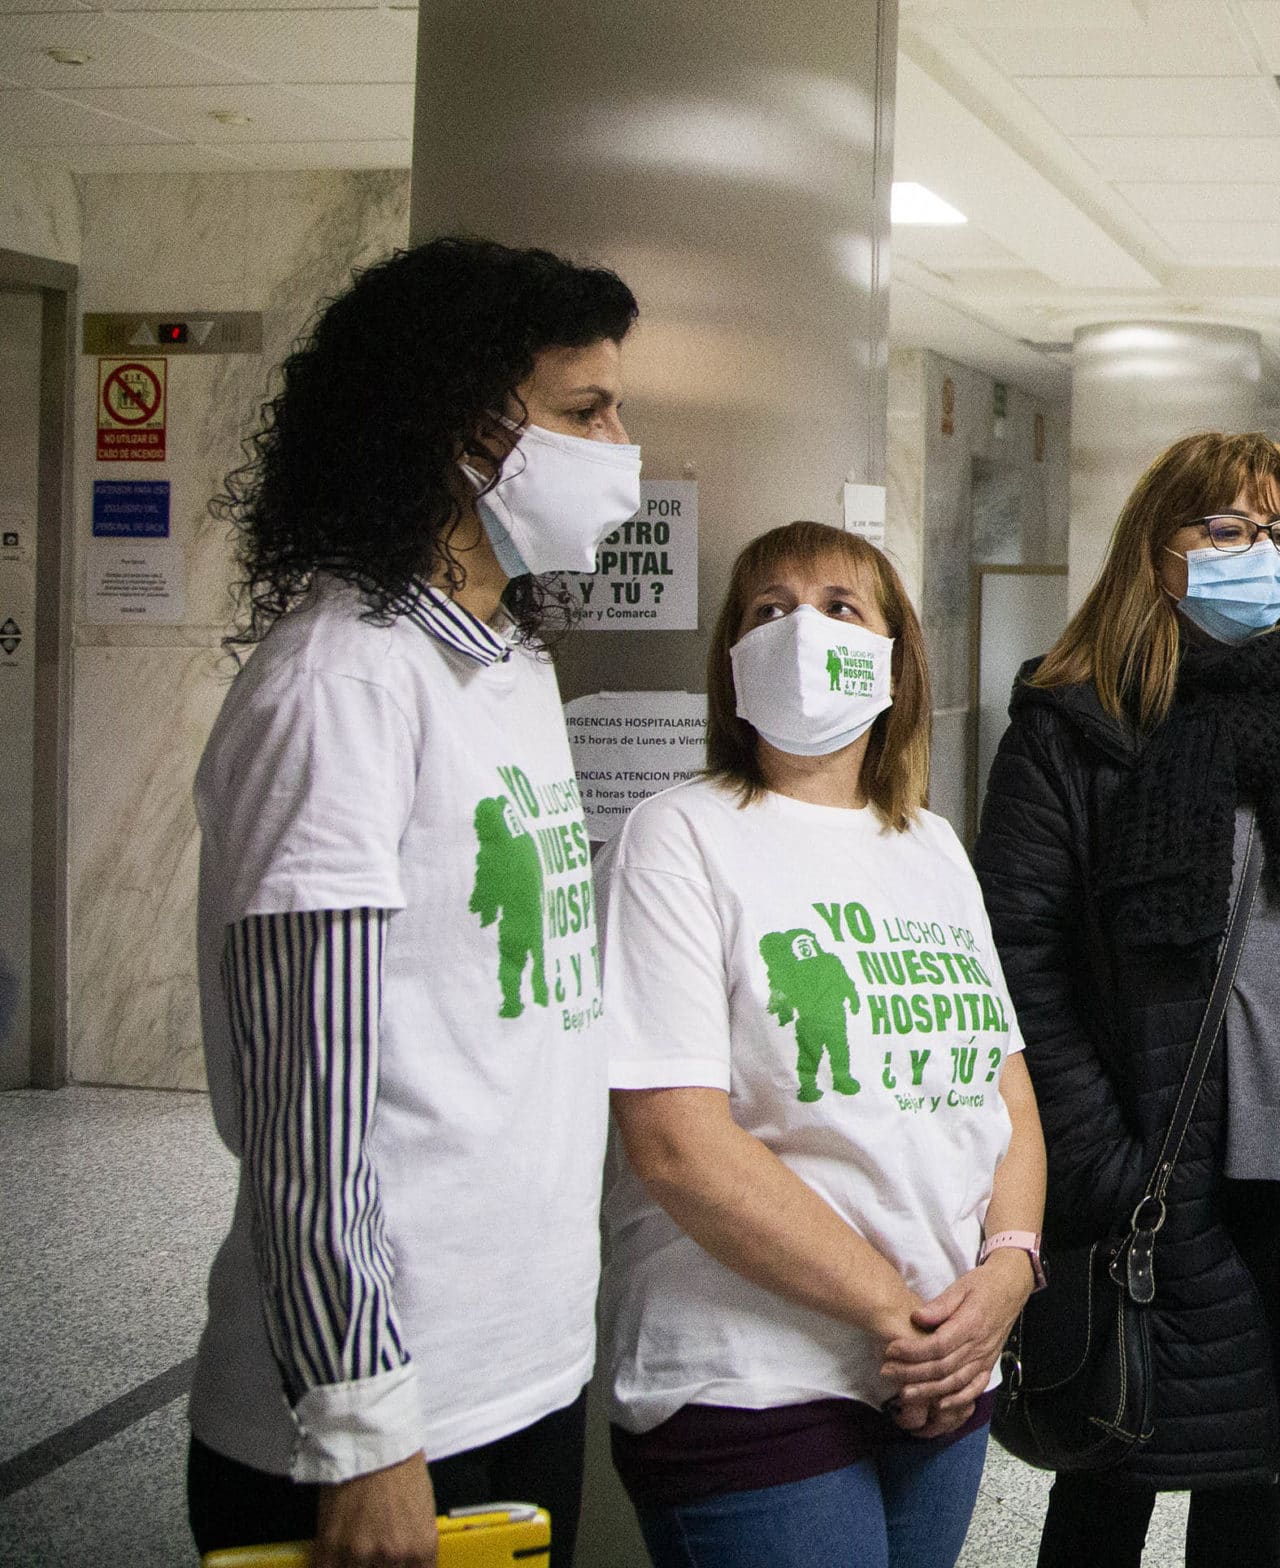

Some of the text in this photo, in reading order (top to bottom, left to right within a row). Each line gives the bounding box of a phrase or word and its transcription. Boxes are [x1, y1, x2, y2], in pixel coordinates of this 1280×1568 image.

[647, 499, 681, 517] POR
[604, 521, 670, 545] STRO
[592, 551, 673, 576] PITAL
[579, 582, 594, 604] Y
[611, 577, 641, 604] TÚ
[650, 582, 665, 604] ?
[597, 611, 603, 621] y
[606, 607, 657, 619] Comarca
[625, 717, 708, 728] HOSPITALARIAS
[574, 735, 586, 745] 15
[589, 735, 618, 745] horas
[621, 735, 634, 745] de
[637, 736, 667, 746] Lunes
[678, 736, 708, 746] Viern
[576, 771, 612, 781] ENCIAS
[615, 771, 671, 781] ATENCION
[497, 764, 540, 818] YO
[587, 789, 593, 798] 8
[596, 788, 625, 799] horas
[597, 804, 634, 814] Domin
[536, 820, 588, 876] NUES
[548, 879, 596, 940] HOSP
[811, 901, 981, 953] YO LUCHO POR
[857, 948, 993, 988] NUESTRO
[867, 992, 1010, 1036] HOSPITAL
[909, 1048, 932, 1086] Y
[930, 1095, 943, 1113] y
